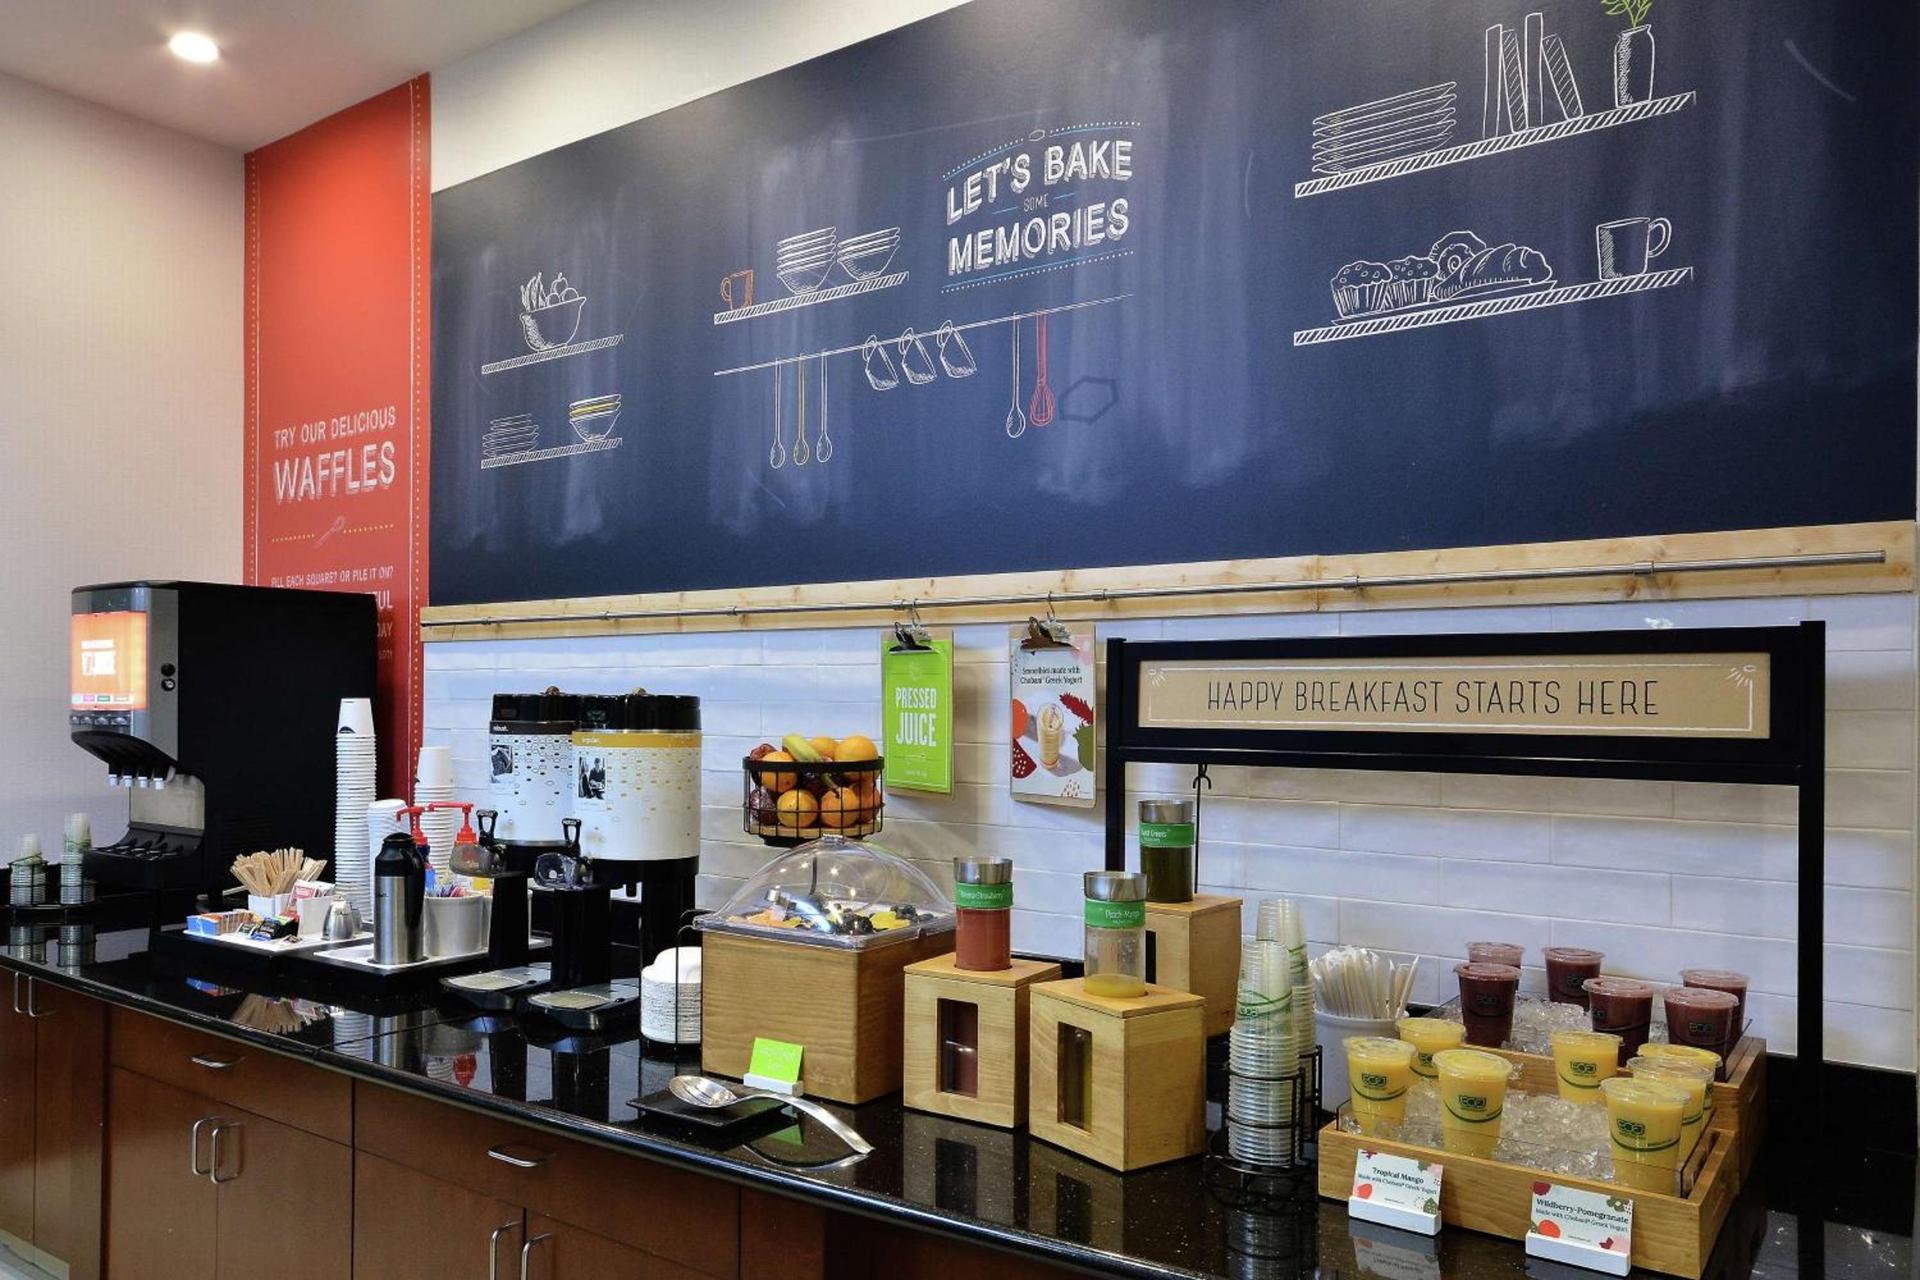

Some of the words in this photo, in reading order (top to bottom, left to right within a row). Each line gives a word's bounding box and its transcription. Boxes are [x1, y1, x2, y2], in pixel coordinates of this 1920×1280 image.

[947, 153, 1031, 226] LET'S
[1044, 140, 1134, 185] BAKE
[1023, 193, 1049, 213] SOME
[948, 198, 1129, 276] MEMORIES
[274, 426, 296, 448] TRY
[301, 421, 326, 444] OUR
[331, 406, 396, 438] DELICIOUS
[274, 441, 396, 504] WAFFLES
[286, 574, 304, 587] EACH
[306, 570, 337, 586] SQUARE?
[340, 570, 350, 582] OR
[353, 568, 368, 581] PILE
[369, 567, 376, 580] IT
[379, 565, 394, 579] ON?
[895, 687, 937, 709] PRESSED
[1207, 681, 1283, 711] HAPPY
[1296, 680, 1443, 713] BREAKFAST
[1456, 680, 1560, 714] STARTS
[1578, 680, 1659, 715] HERE
[896, 712, 937, 747] JUICE
[1372, 1166, 1400, 1180] Tropical
[1401, 1173, 1425, 1184] Mango
[1536, 1198, 1629, 1224] Wildberry-Pomegranate
